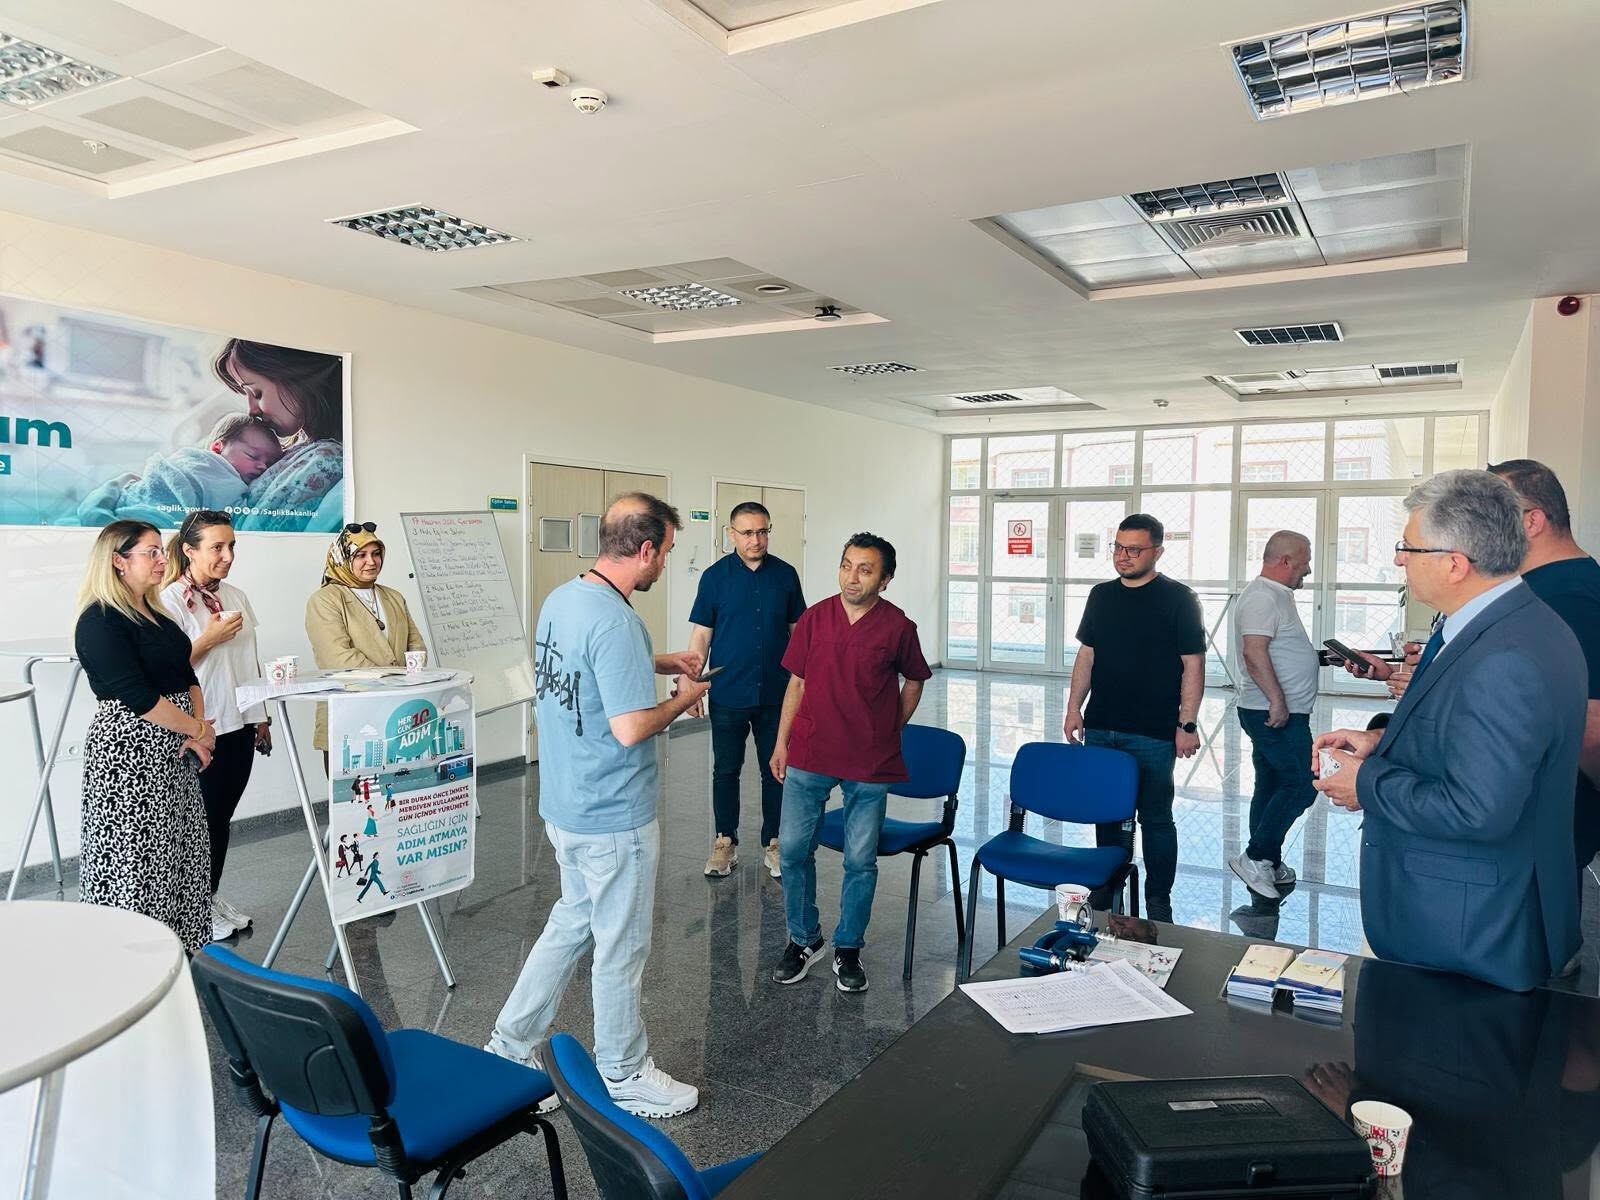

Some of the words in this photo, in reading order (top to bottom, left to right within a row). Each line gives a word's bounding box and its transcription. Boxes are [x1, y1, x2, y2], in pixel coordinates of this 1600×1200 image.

[156, 504, 210, 514] saglik.govtr
[397, 715, 412, 727] HER
[411, 794, 432, 804] DURAK
[432, 792, 469, 806] KULLANMAYA
[396, 836, 426, 852] ADIM
[428, 826, 468, 844] ATMAYA
[396, 851, 423, 866] VAR
[426, 838, 468, 860] MISIN?
